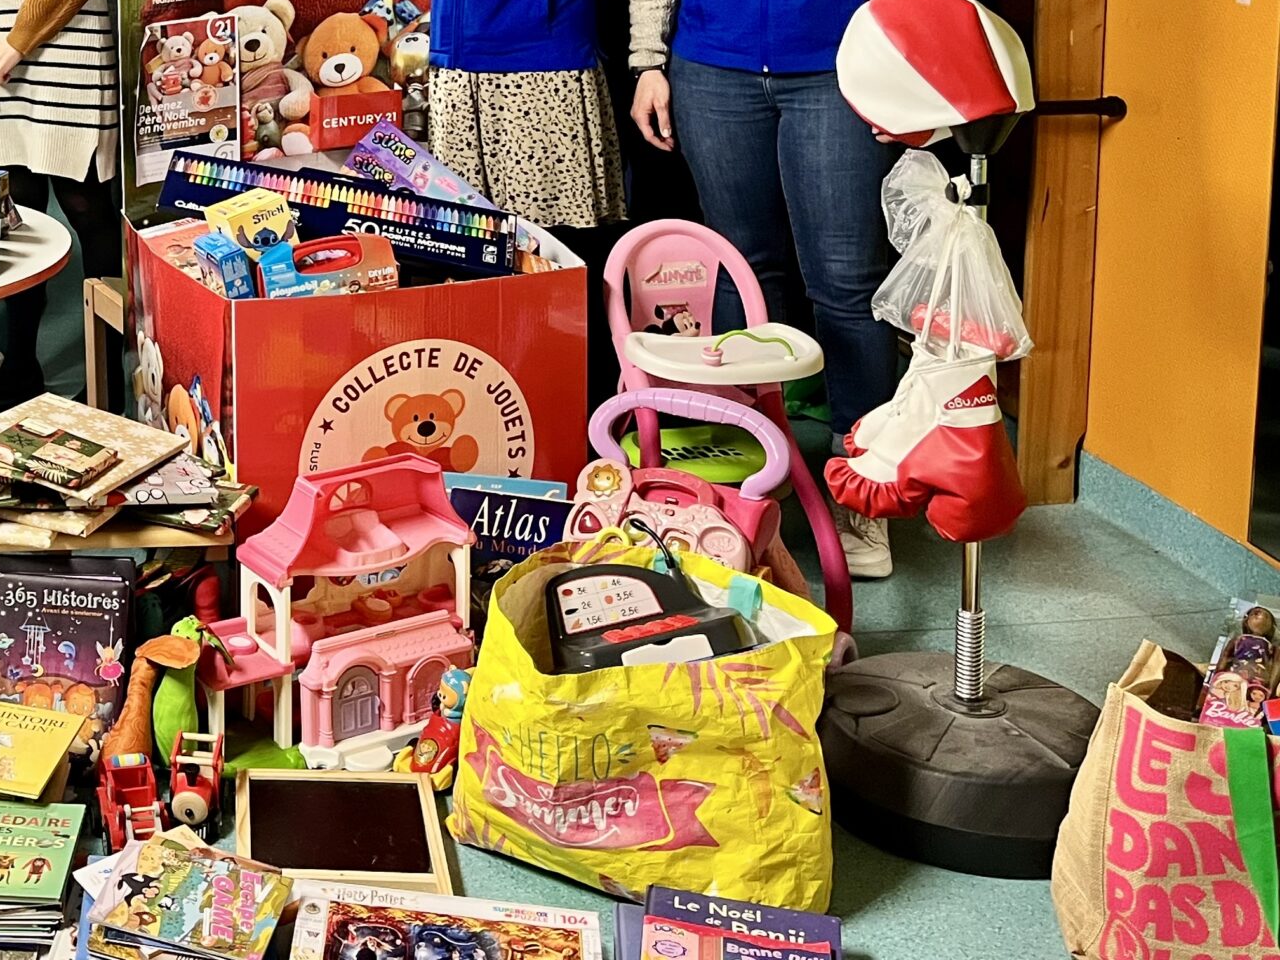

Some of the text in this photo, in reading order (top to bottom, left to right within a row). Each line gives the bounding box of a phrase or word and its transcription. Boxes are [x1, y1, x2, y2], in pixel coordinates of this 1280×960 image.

[139, 101, 182, 115] Devenez
[138, 109, 189, 126] Père Noël
[139, 116, 206, 135] en novembre
[323, 112, 397, 128] CENTURY 21
[341, 218, 431, 240] 50 FEUTRES
[427, 246, 444, 254] FELT
[446, 250, 466, 258] PENS
[270, 280, 318, 298] playmobil
[332, 348, 526, 459] COLLECTE DE JOUETS
[310, 441, 321, 471] PLUS
[471, 496, 550, 543] Atlas
[491, 540, 536, 556] Mond
[4, 587, 120, 610] 365 Histoires
[581, 601, 592, 610] 2€
[1205, 700, 1257, 727] Barbie
[520, 731, 612, 783] HELLO
[489, 765, 640, 835] Summer
[337, 888, 405, 906] Harry Potter
[211, 876, 235, 943] GAME
[673, 896, 761, 922] Le Noël
[514, 913, 589, 926] PUZZLE 104
[705, 916, 721, 926] de
[726, 942, 782, 959] Bonne
